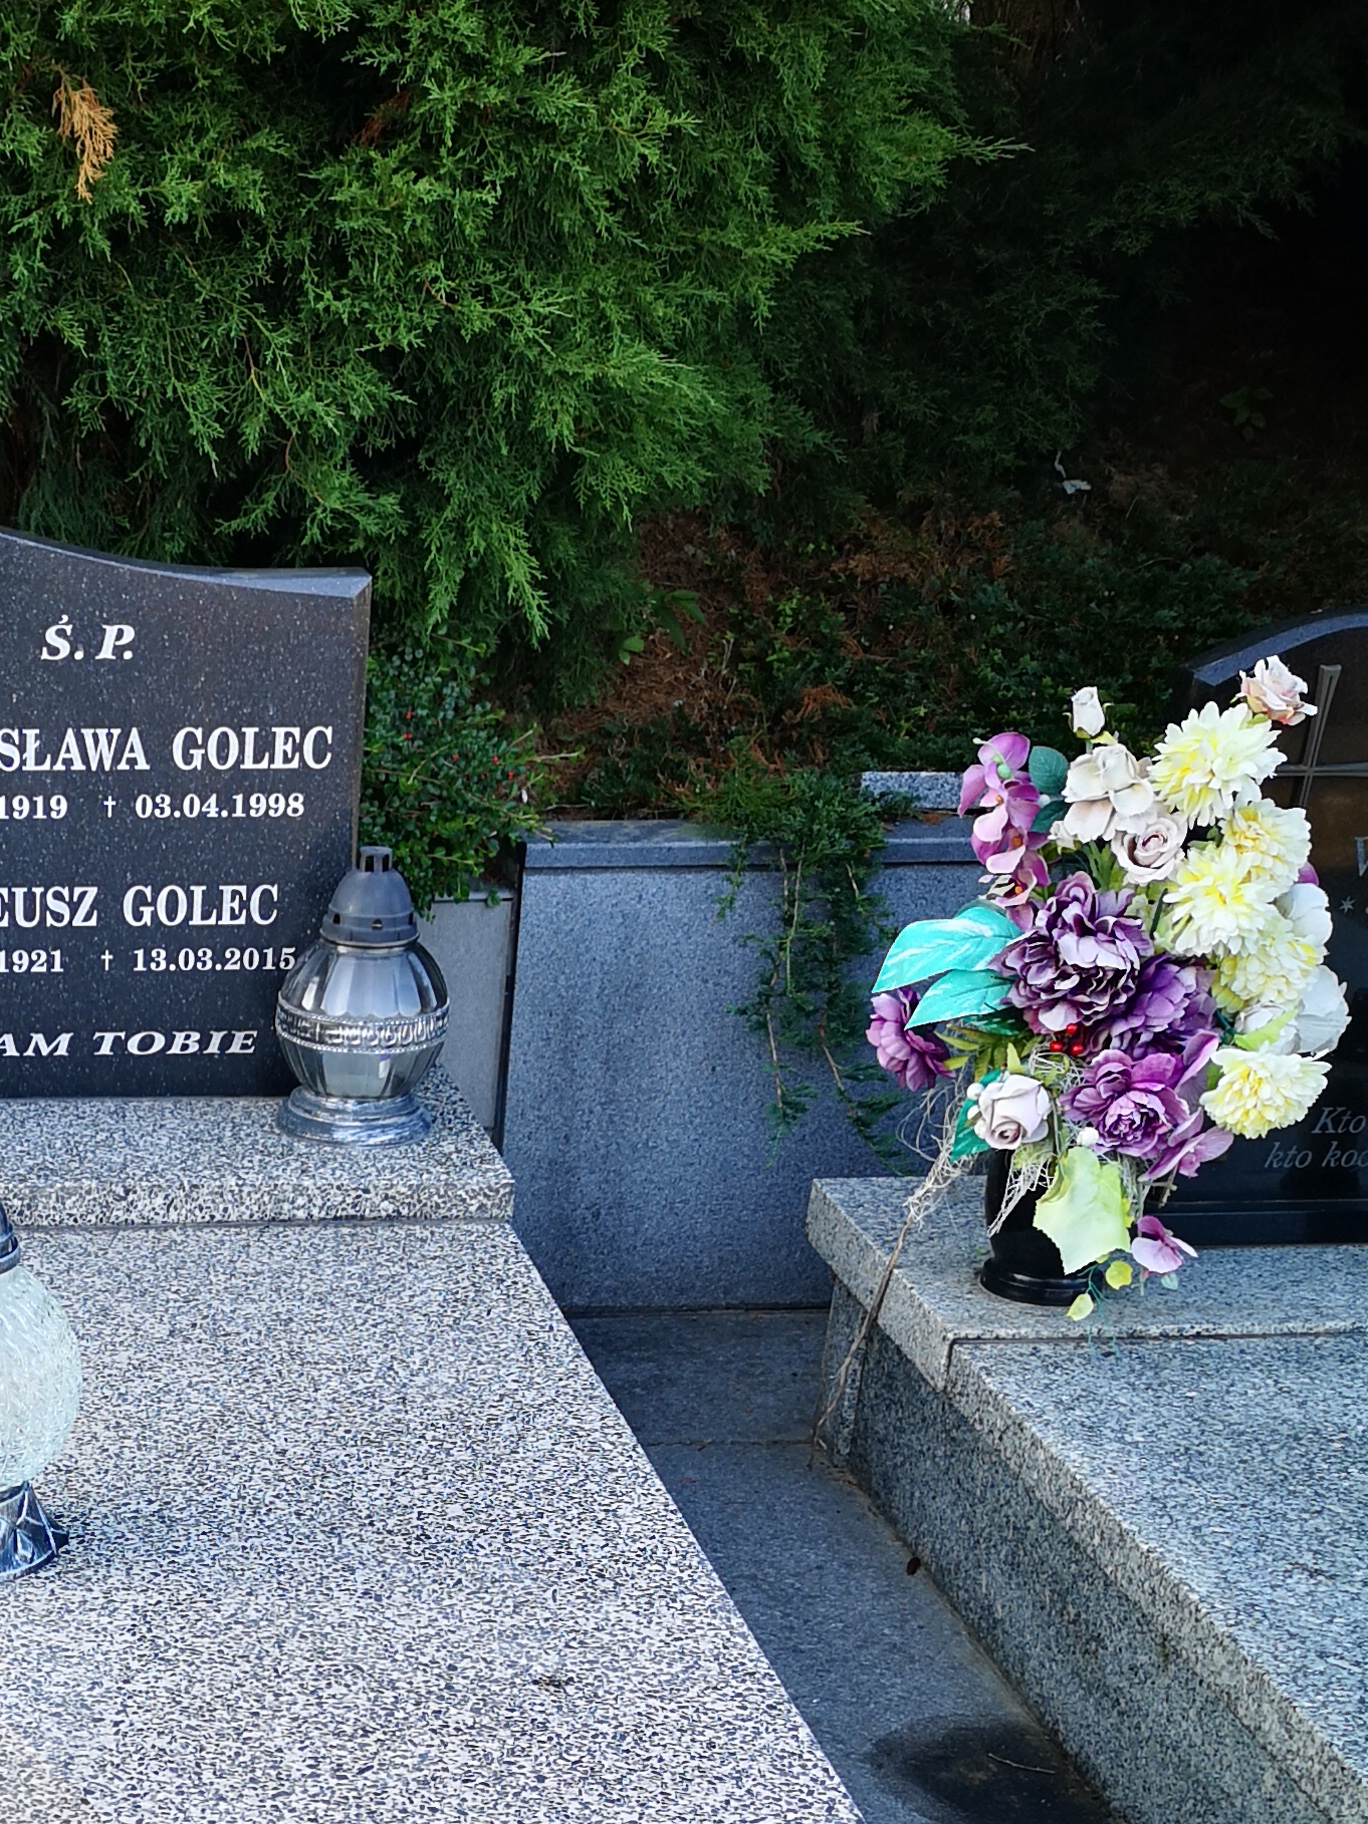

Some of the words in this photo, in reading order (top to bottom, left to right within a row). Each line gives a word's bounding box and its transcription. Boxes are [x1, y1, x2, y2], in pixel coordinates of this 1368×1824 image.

[40, 614, 84, 660] Ś.
[94, 624, 135, 660] P.
[172, 726, 333, 770] GOLEC
[135, 792, 305, 819] 03.04.1998
[122, 883, 279, 927] GOLEC
[133, 946, 296, 972] 13.03.2015
[93, 1030, 258, 1056] TOBIE
[1311, 1107, 1367, 1134] Kto
[1264, 1141, 1313, 1169] kto
